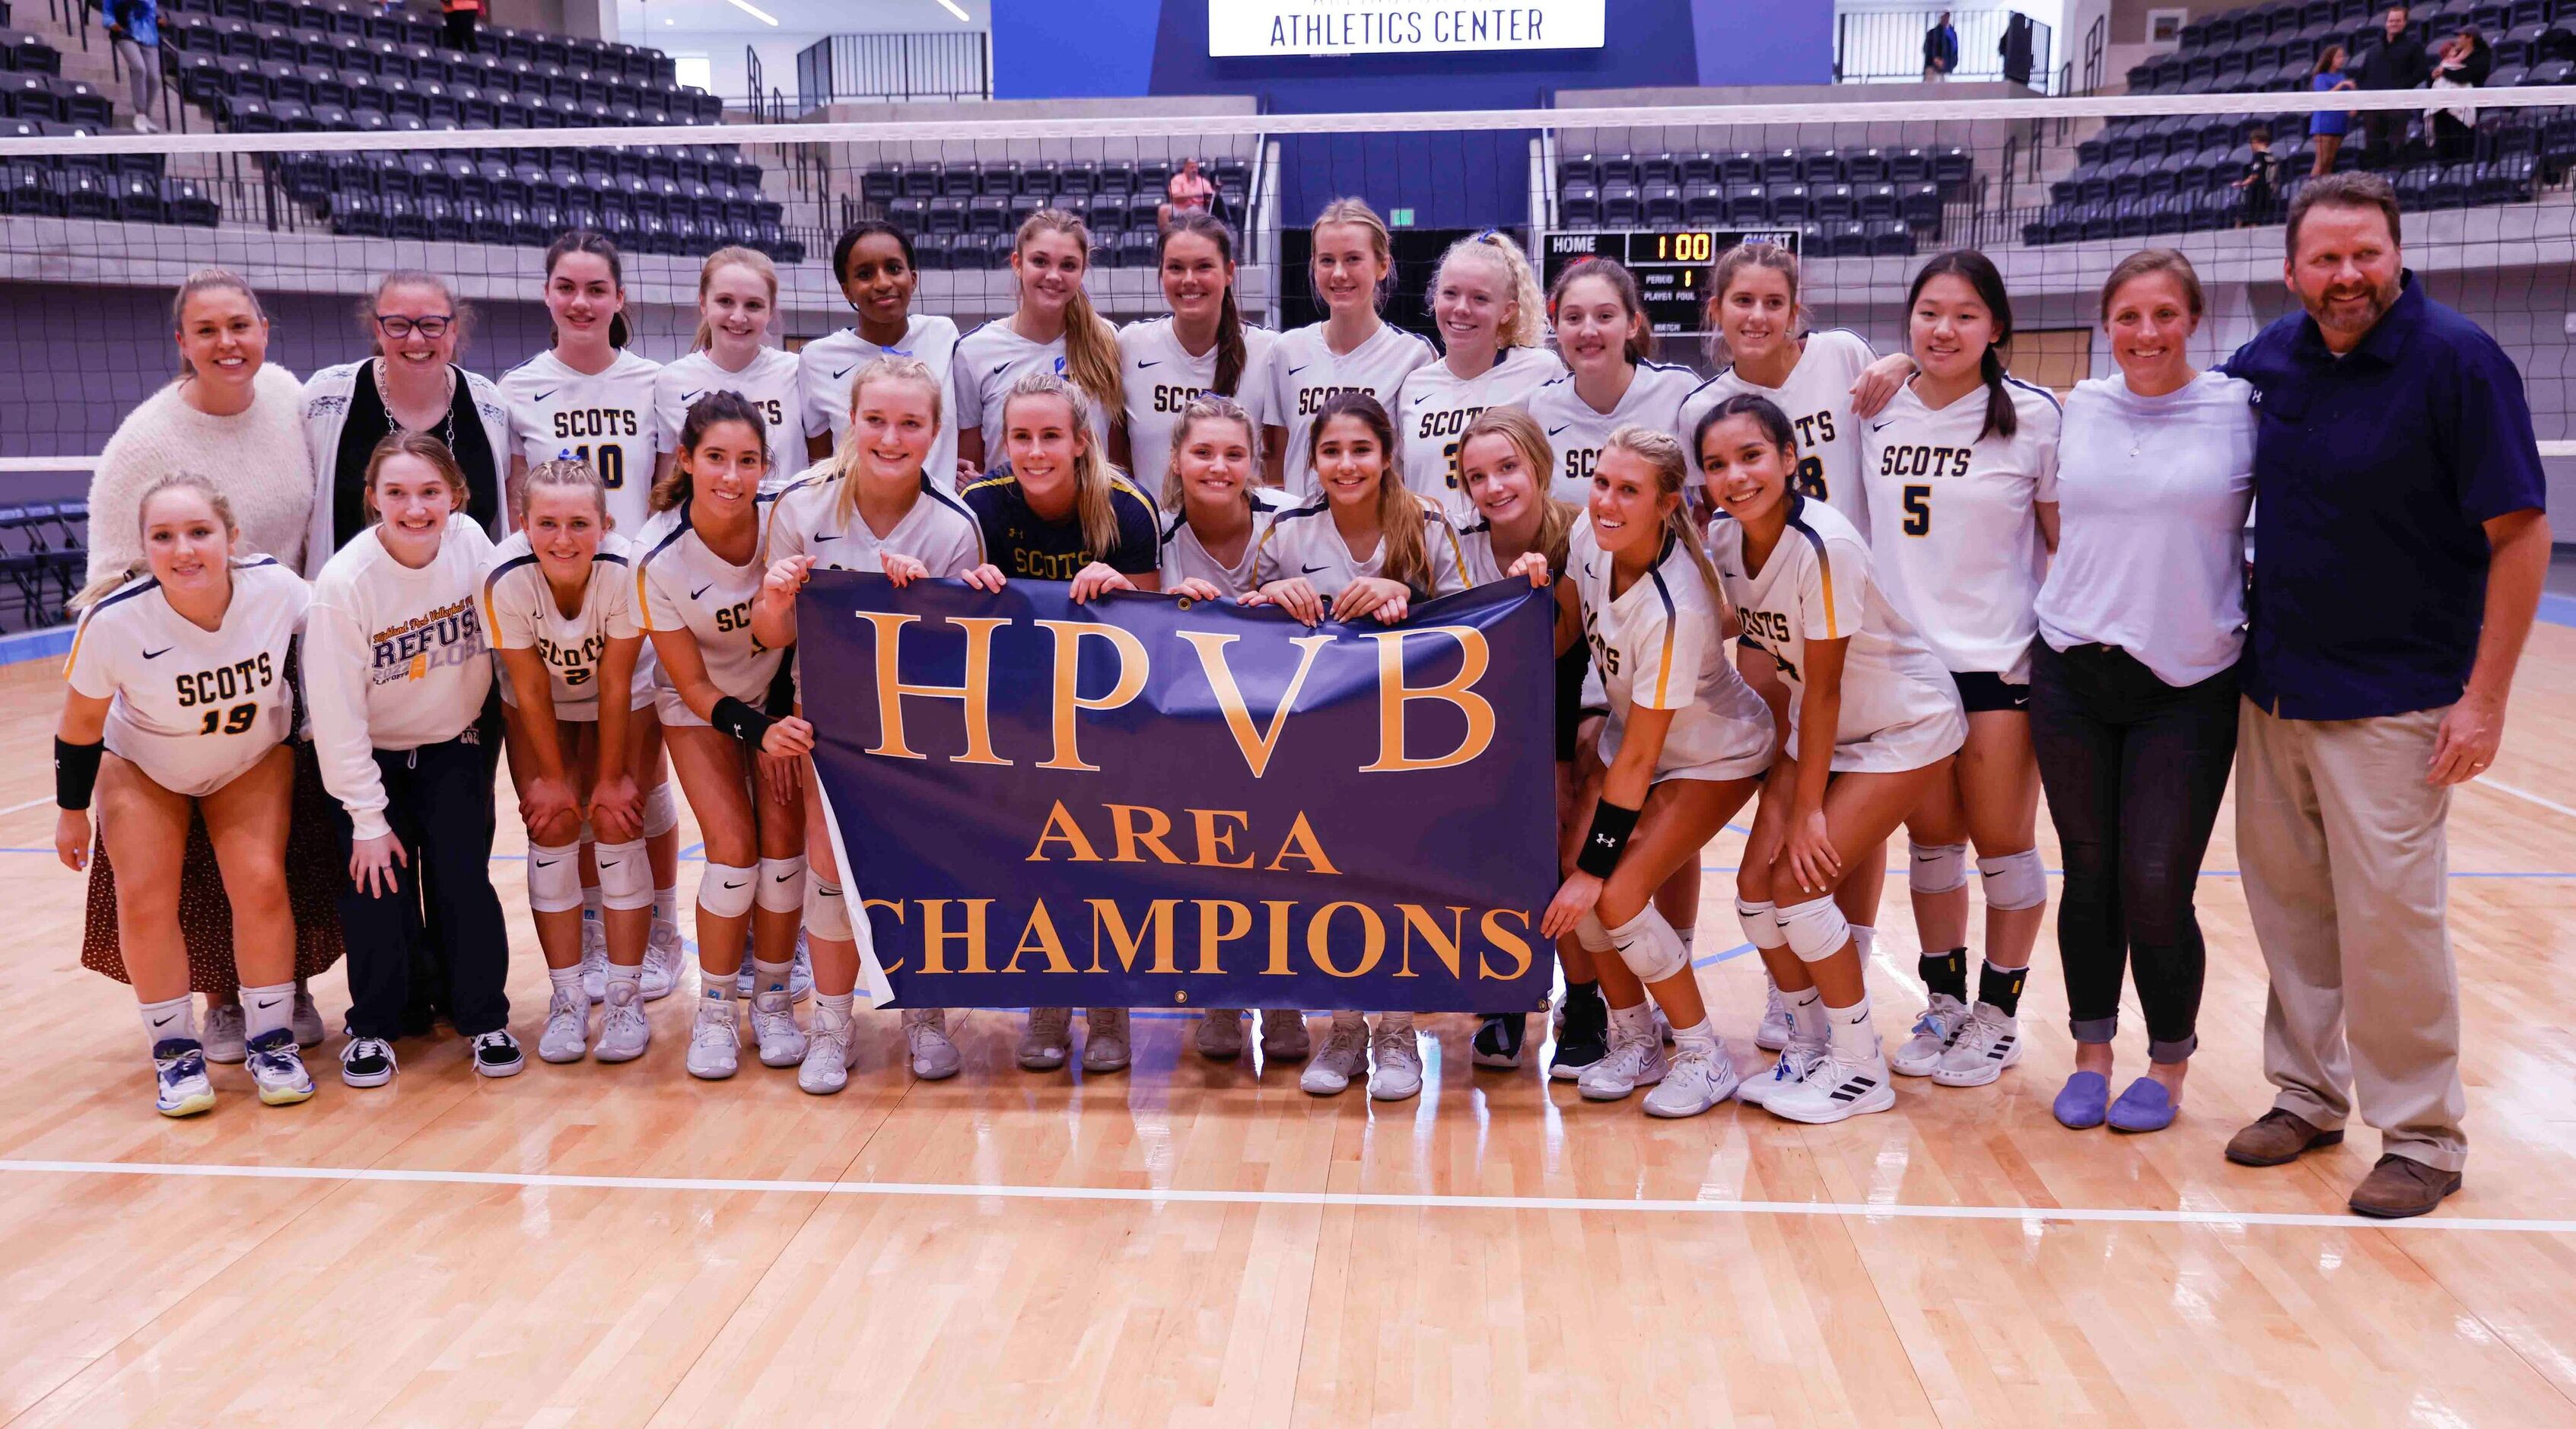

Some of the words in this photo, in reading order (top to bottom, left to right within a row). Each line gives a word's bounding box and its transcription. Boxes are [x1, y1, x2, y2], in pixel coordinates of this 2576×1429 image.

[1270, 11, 1421, 46] ATHLETICS
[1435, 9, 1543, 43] CENTER
[1553, 235, 1596, 253] HOME
[1646, 274, 1674, 285] PERIOD
[1676, 291, 1696, 301] FOUL
[554, 409, 637, 438] SCOTS
[1419, 406, 1496, 439] SCOT
[1881, 445, 1972, 477] SCOTS
[1902, 484, 1932, 537] 5
[1015, 547, 1093, 580] SCOTS
[373, 620, 409, 644] Highland
[428, 598, 466, 622] Volleyball
[177, 651, 273, 708] SCOTS
[856, 610, 1496, 778] HPVB
[199, 701, 259, 736] 19
[1025, 799, 1343, 874] AREA
